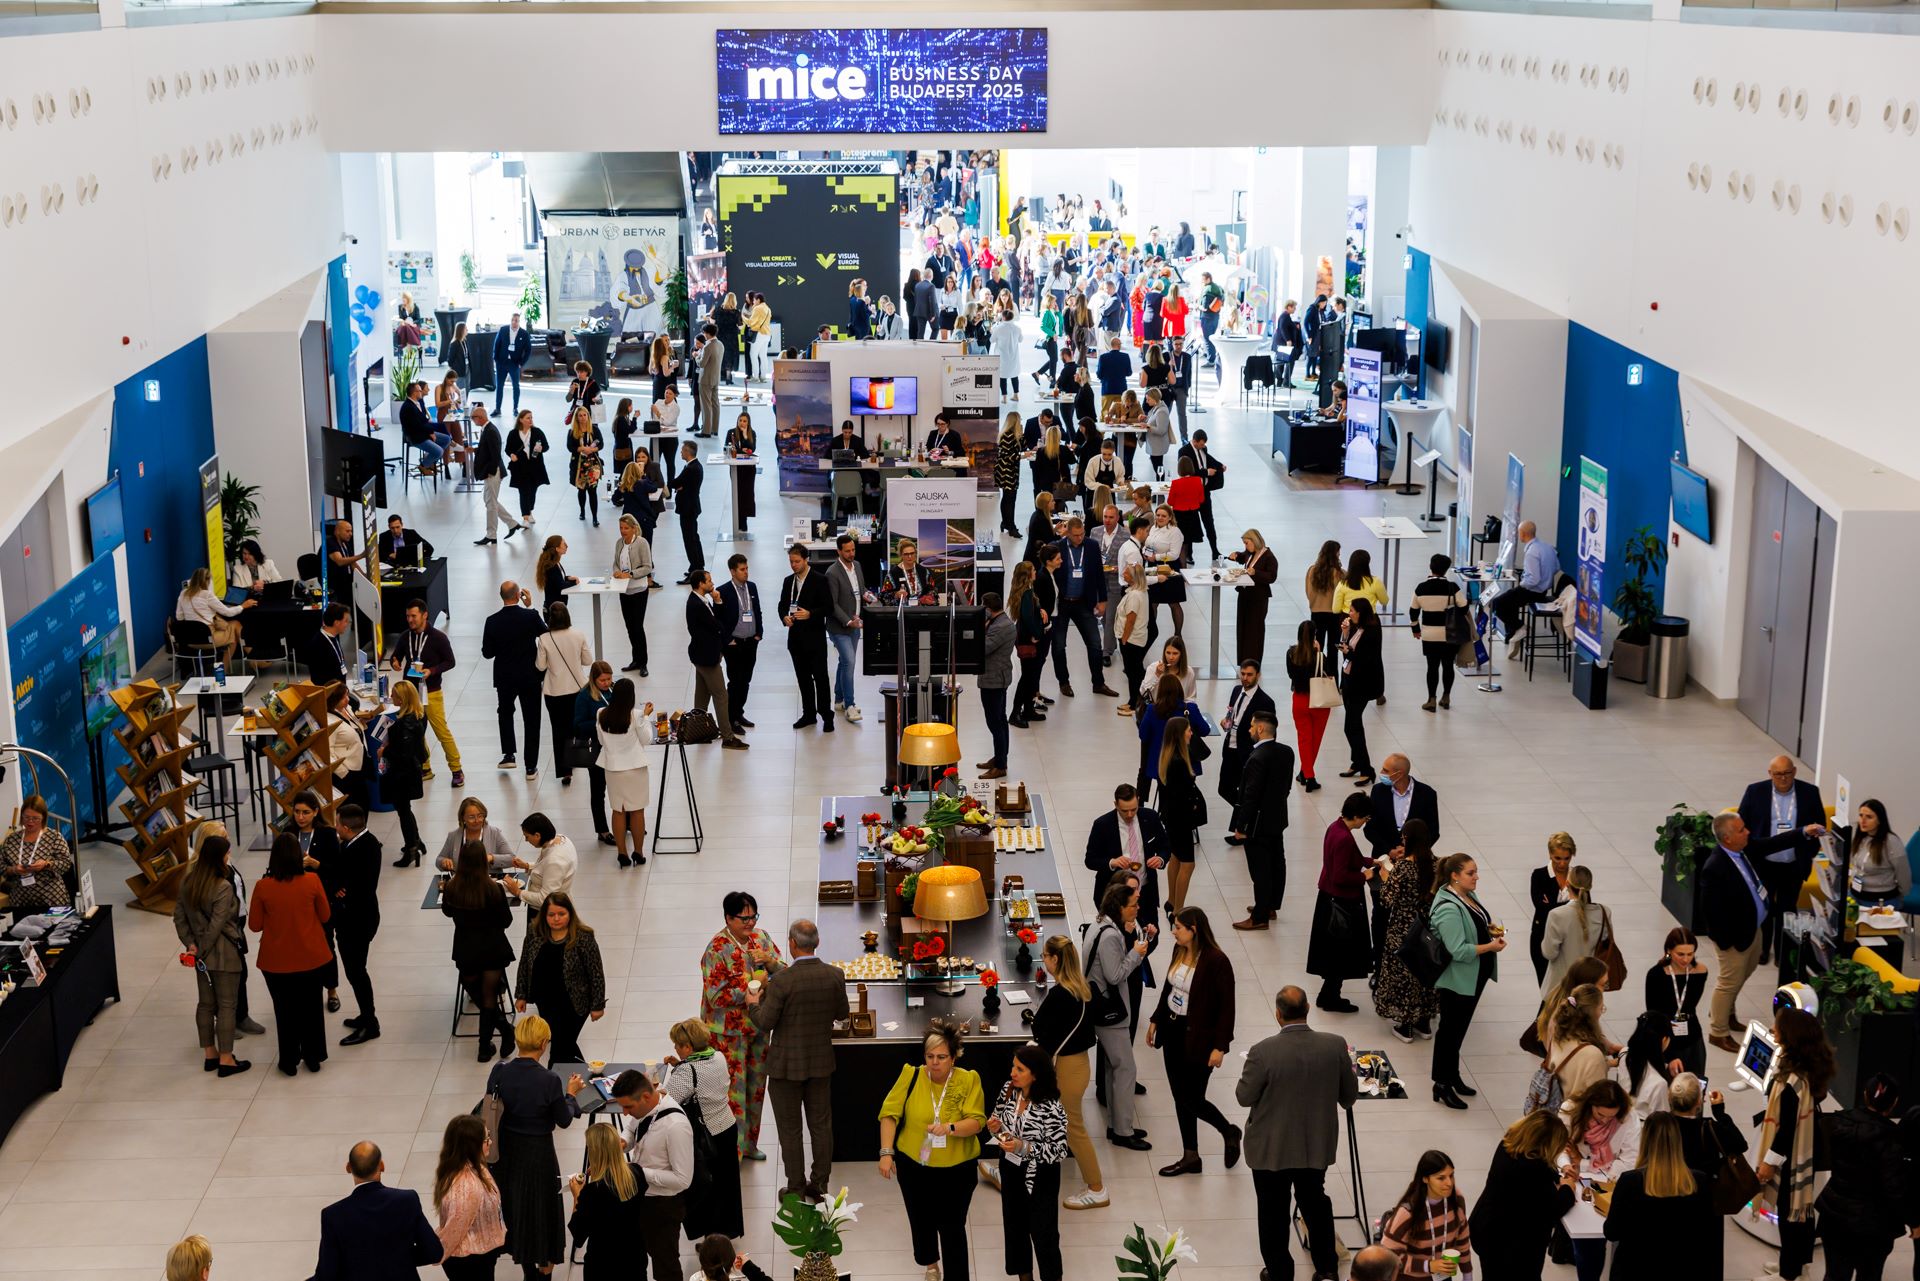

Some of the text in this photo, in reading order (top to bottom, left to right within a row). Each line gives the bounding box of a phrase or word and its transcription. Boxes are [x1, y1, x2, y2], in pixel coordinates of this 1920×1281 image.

[747, 53, 867, 100] mice
[889, 66, 1024, 81] BUSINESS DAY
[889, 83, 1024, 99] BUDAPEST 2025
[560, 228, 599, 236] URBAN
[915, 492, 949, 500] SAUSKA
